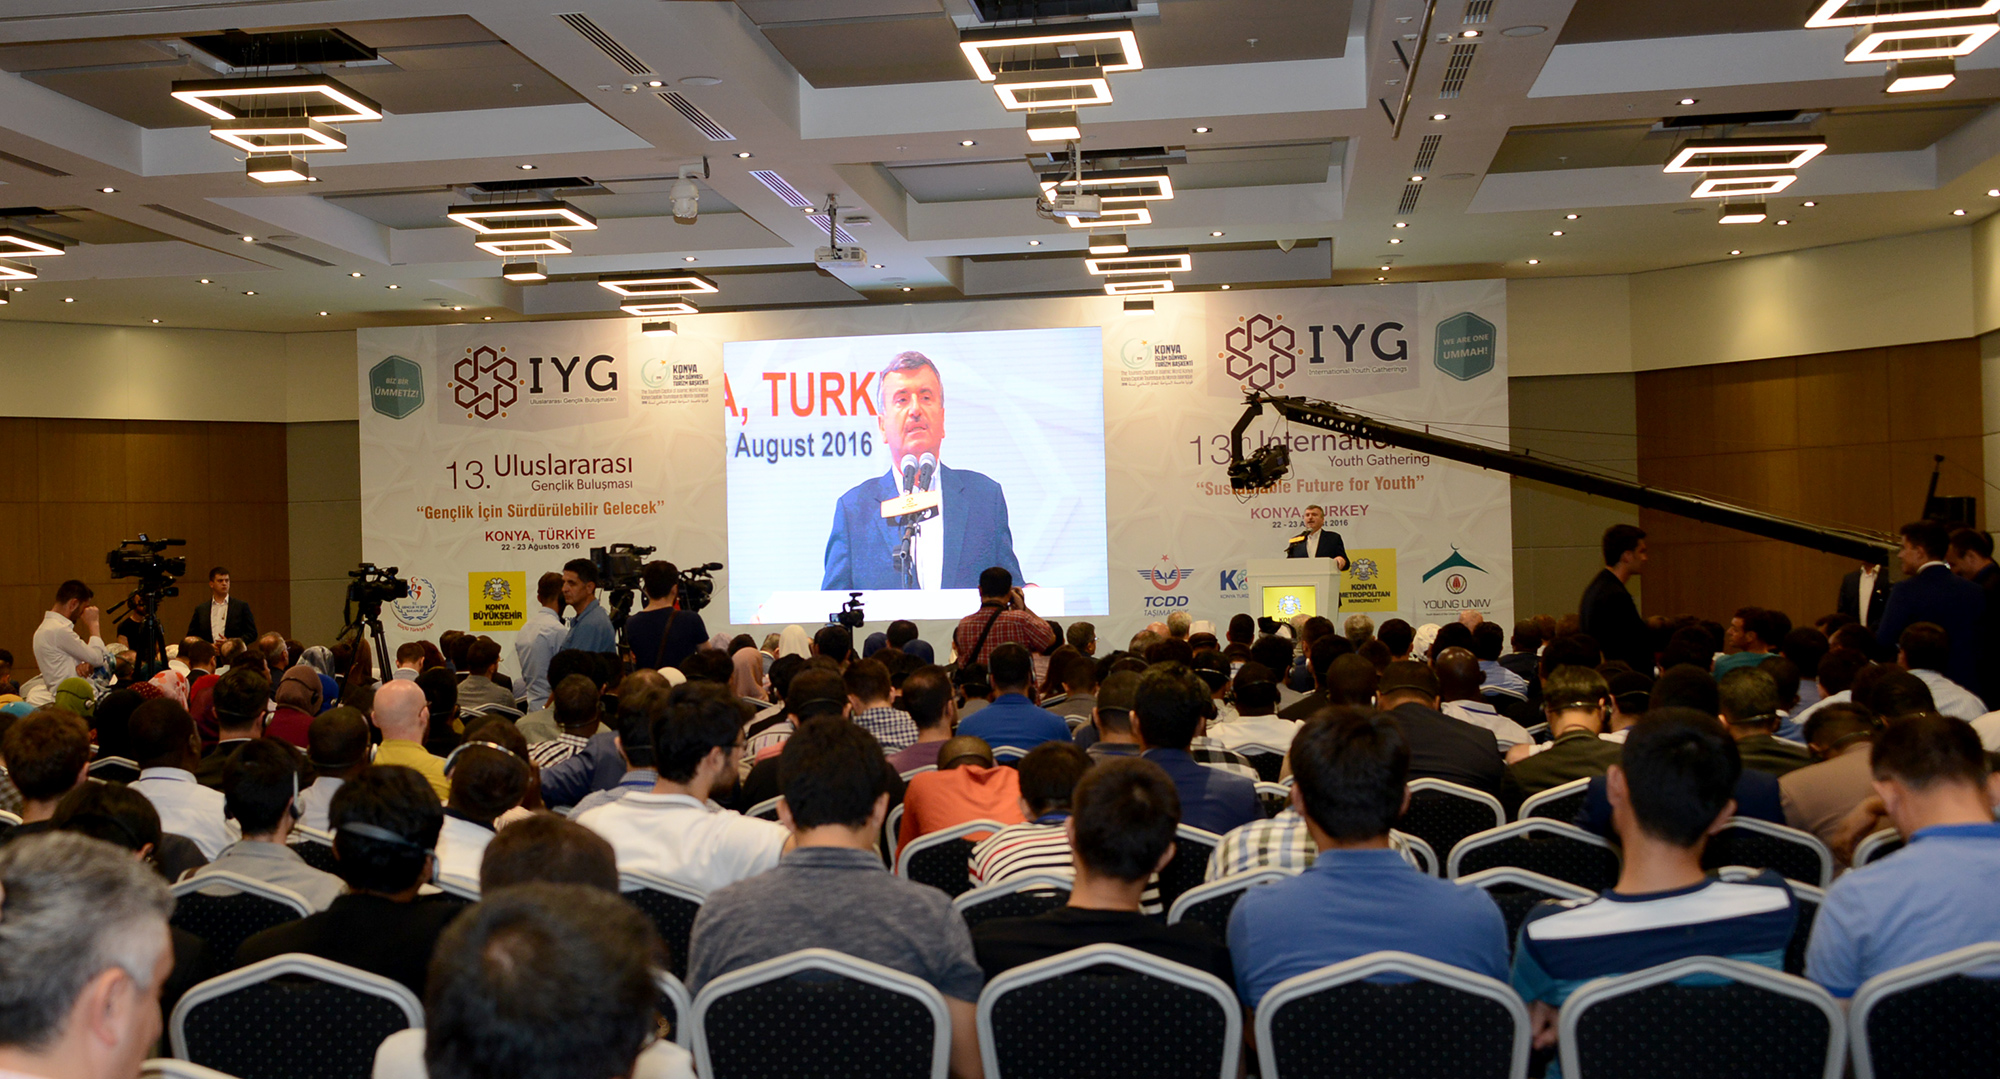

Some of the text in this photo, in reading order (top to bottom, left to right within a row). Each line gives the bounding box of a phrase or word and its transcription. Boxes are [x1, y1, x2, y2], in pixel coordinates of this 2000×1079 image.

[1309, 322, 1407, 364] IYG
[1472, 334, 1489, 342] ONE
[1155, 344, 1181, 354] KONYA
[1444, 347, 1488, 359] UMMAH!
[529, 355, 617, 393] IYG
[673, 364, 698, 374] KONYA
[374, 386, 419, 398] ÜMMETİZ!
[762, 372, 882, 416] TURK
[734, 432, 872, 464] August 2016
[1328, 453, 1430, 467] Youth Gathering
[446, 453, 632, 489] 13. Uluslararası
[531, 478, 632, 492] Gençlik Buluşması
[1297, 478, 1344, 493] Future
[1349, 477, 1369, 491] for
[1374, 475, 1424, 490] Youth”
[417, 500, 664, 522] “Gençlik İçin Sürdürülebilir Gelecek”
[485, 527, 596, 542] KONYA, TÜRKİYE
[528, 543, 560, 551] Ağustos
[1144, 596, 1189, 607] TCDD
[1423, 599, 1459, 609] YOUNG
[473, 610, 522, 620] BÜYÜKŞEHİR
